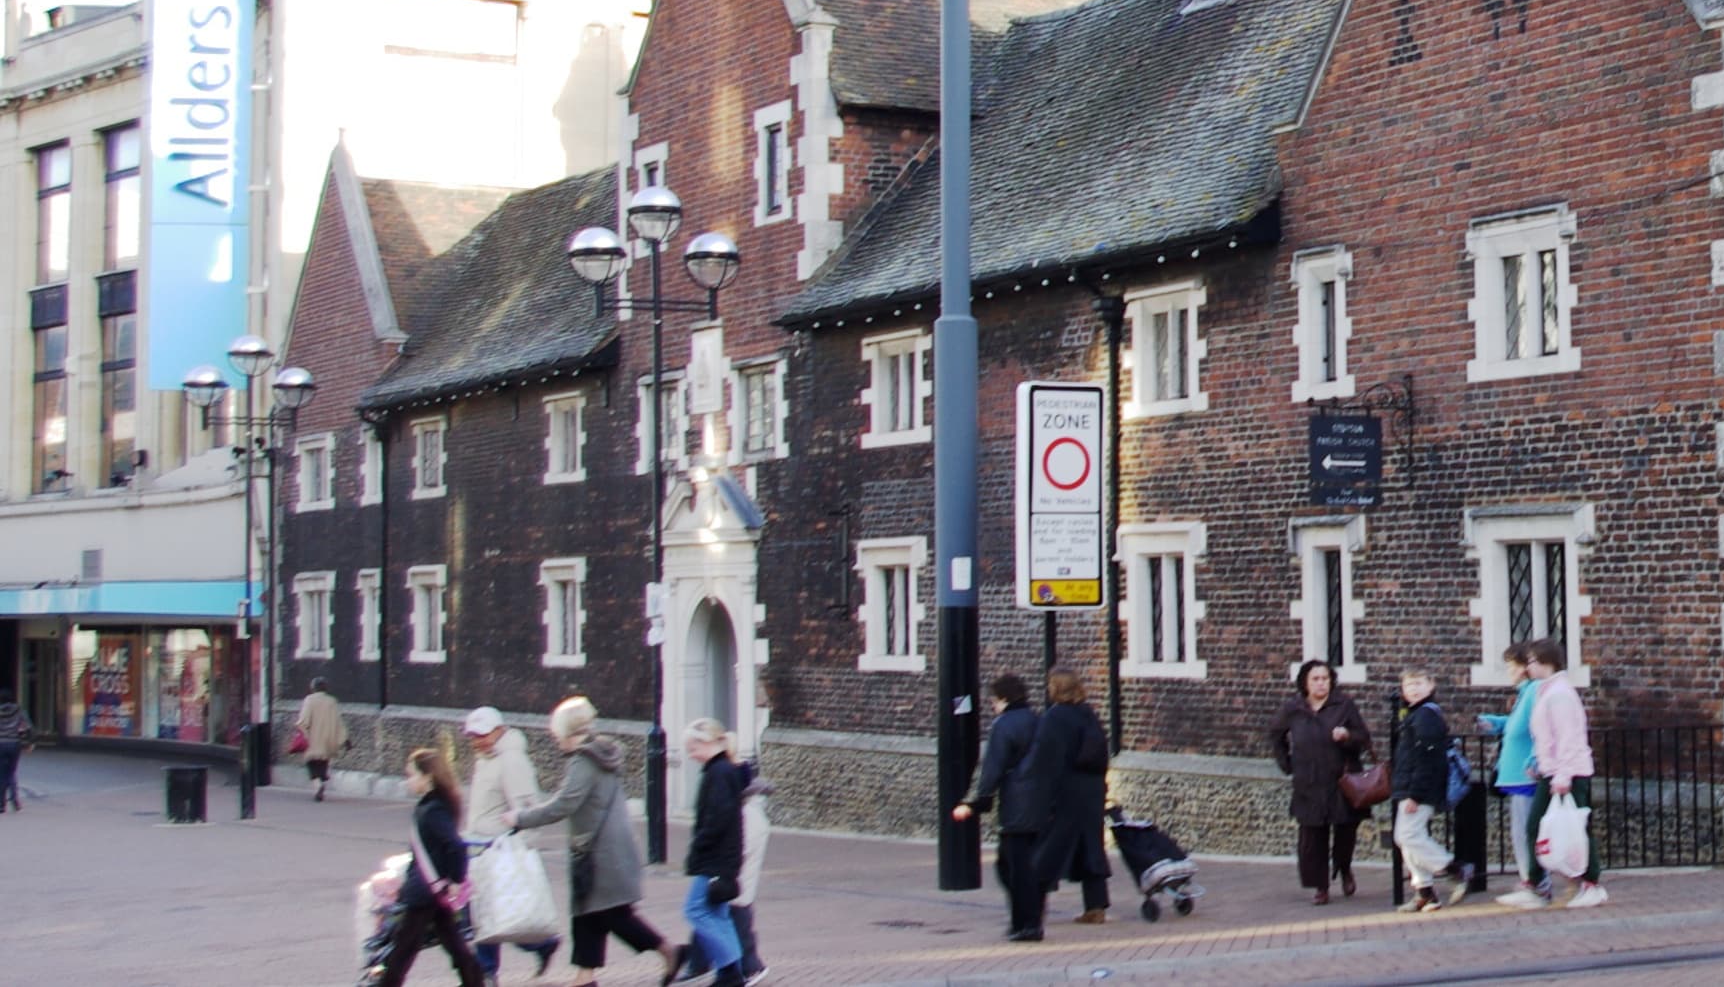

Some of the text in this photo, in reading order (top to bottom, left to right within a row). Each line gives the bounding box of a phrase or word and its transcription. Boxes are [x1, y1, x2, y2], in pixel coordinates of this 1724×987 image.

[168, 5, 232, 208] Allders
[1042, 413, 1091, 430] ZONE
[91, 674, 130, 695] CROSS
